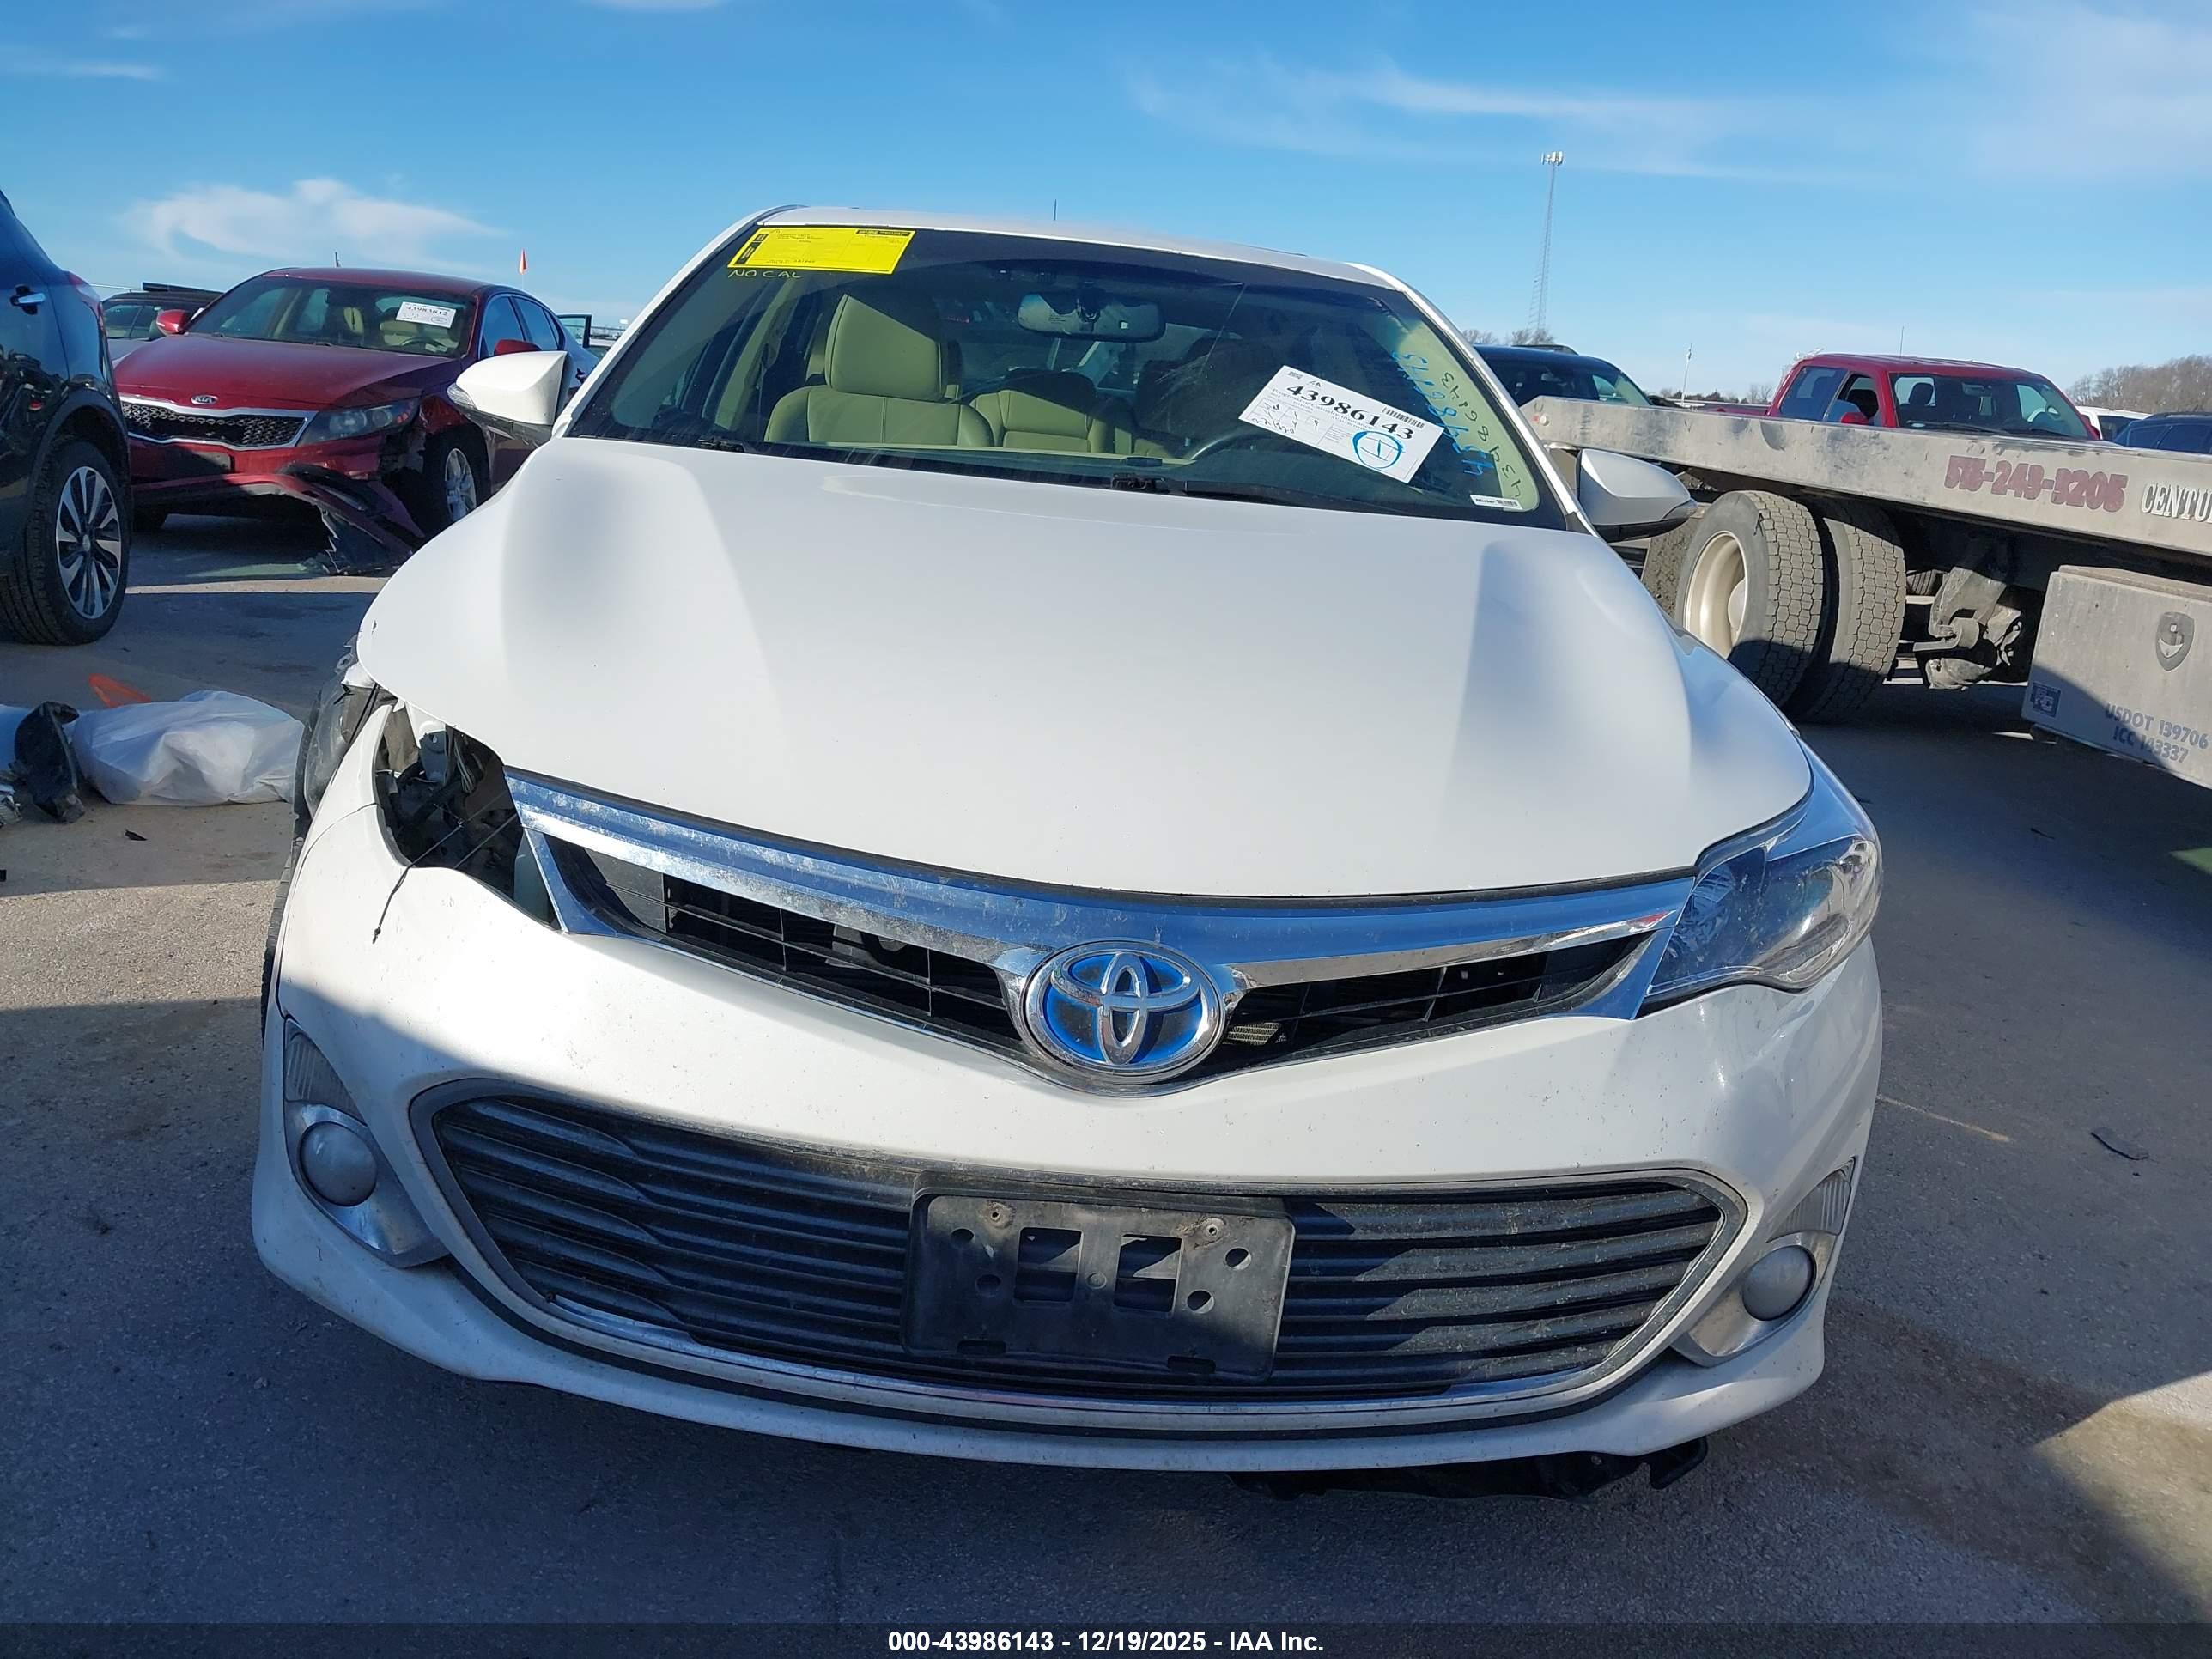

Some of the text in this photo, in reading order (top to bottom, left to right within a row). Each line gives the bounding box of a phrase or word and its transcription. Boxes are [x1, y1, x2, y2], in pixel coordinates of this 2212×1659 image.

[728, 269, 802, 278] NO CAL
[1286, 386, 1414, 440] 43986143
[2104, 702, 2209, 749] USDOT 139706
[2112, 725, 2189, 763] ICC 143337
